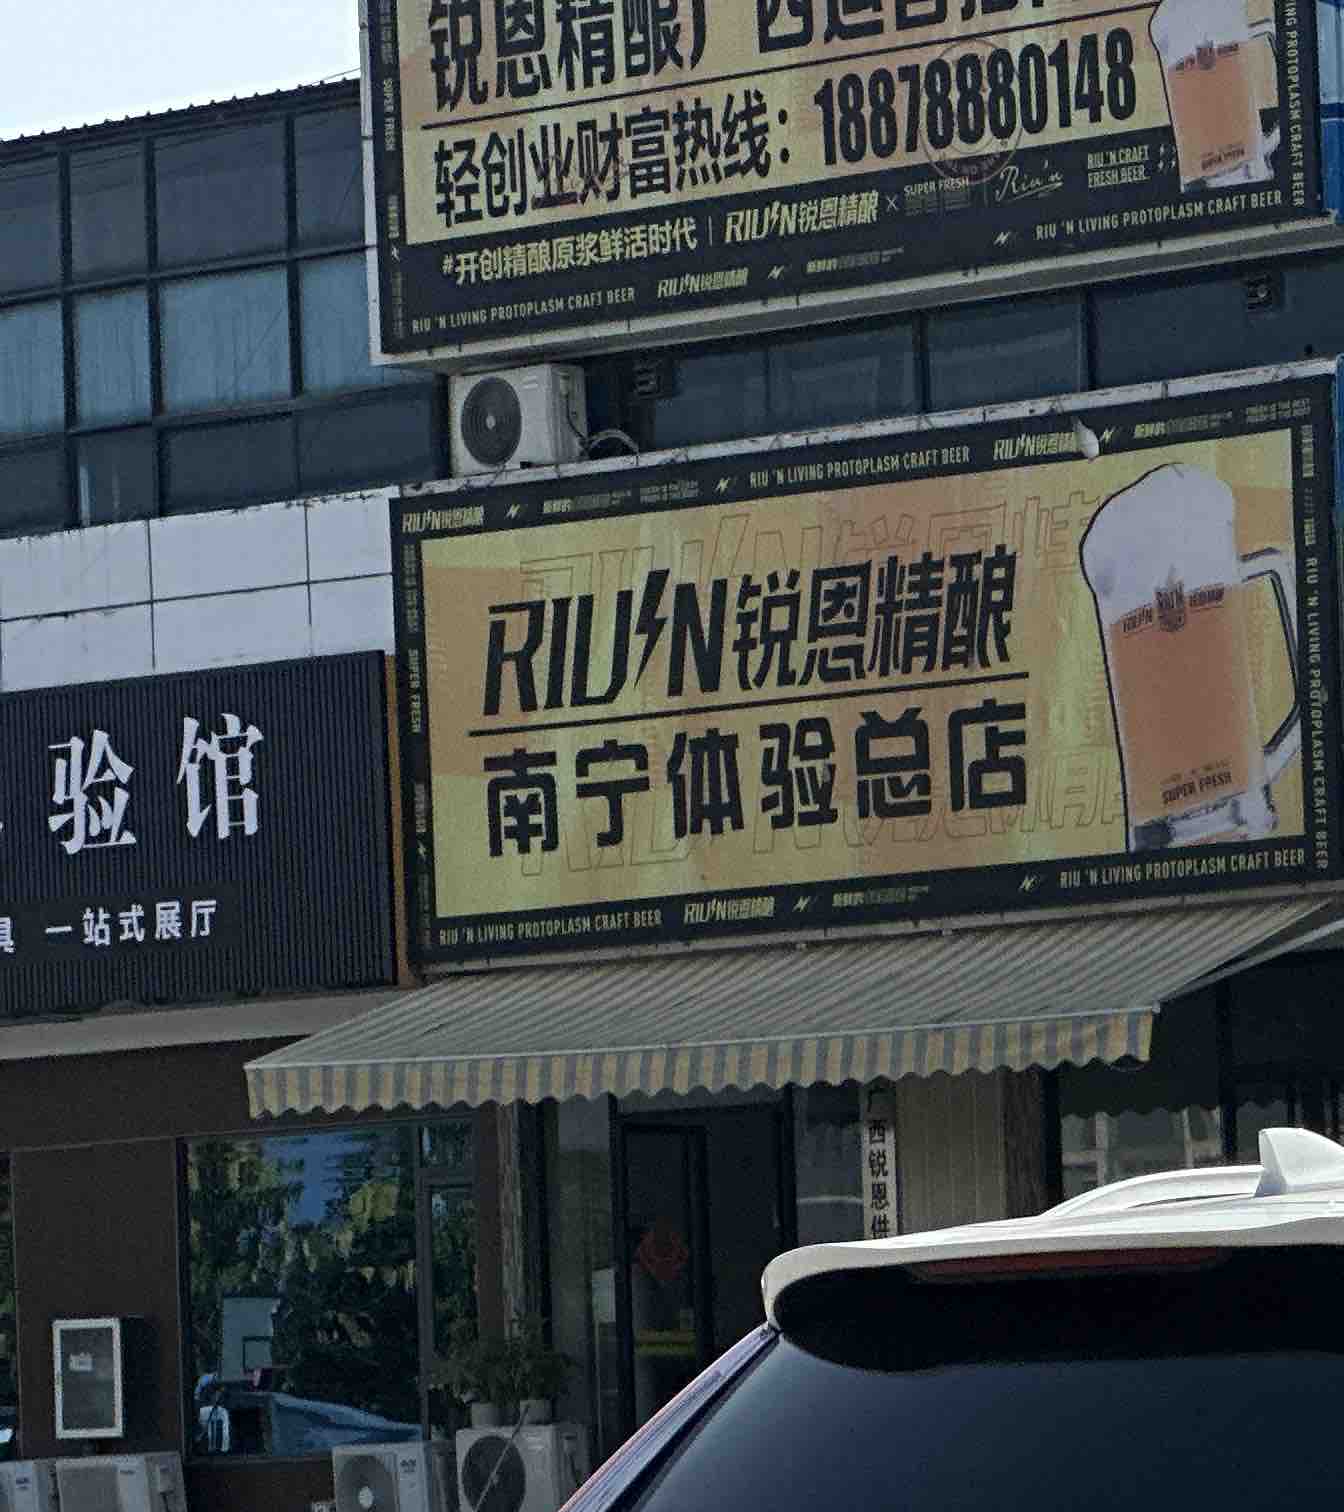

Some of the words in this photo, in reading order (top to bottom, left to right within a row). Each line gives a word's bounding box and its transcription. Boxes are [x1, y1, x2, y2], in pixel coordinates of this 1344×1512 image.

[814, 27, 1137, 166] 18878880148
[1077, 212, 1120, 233] LIVING
[1122, 201, 1203, 226] PROTOPLASM
[1207, 195, 1247, 216] CRAFT
[1250, 189, 1283, 207] BEER
[1292, 172, 1305, 206] BEER
[449, 308, 488, 328] LIVING
[490, 297, 565, 322] PROTOPLASM
[787, 463, 824, 483] LIVING
[902, 449, 938, 469] CRAFT
[1305, 612, 1321, 663] LIVING
[483, 699, 1027, 858] 南宁体验总店
[1312, 776, 1327, 824] CRAFT
[1102, 864, 1142, 885] LIVING
[1146, 857, 1227, 880] PROTOPLASM
[1230, 852, 1270, 873] CRAFT
[1273, 847, 1305, 867] BEER
[45, 900, 217, 946] 一站式展厅
[477, 923, 515, 943] LIVING
